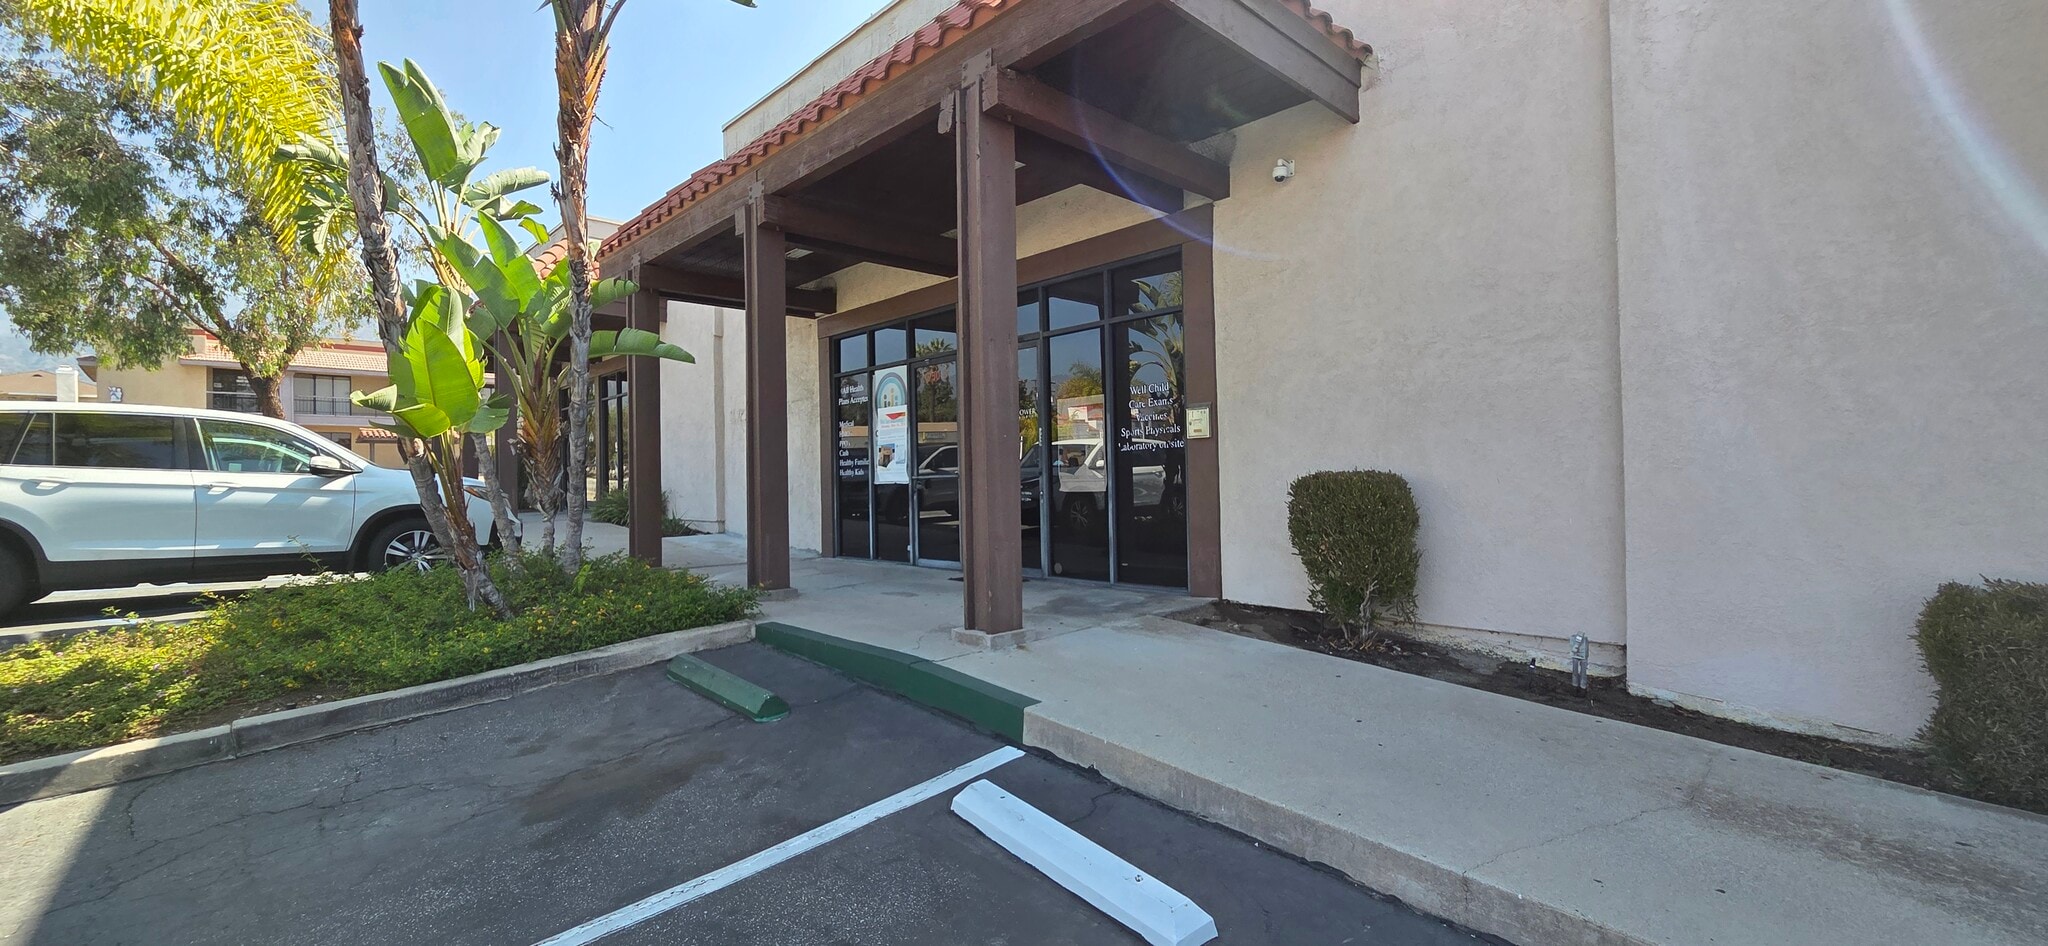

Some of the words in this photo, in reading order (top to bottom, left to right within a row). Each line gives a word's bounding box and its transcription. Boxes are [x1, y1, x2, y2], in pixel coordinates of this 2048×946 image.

[850, 384, 864, 393] Health
[1130, 385, 1147, 395] Well
[1148, 382, 1170, 394] Child
[839, 398, 850, 406] Plans
[850, 396, 869, 405] Accepte
[1129, 400, 1146, 410] Care
[1148, 397, 1175, 408] Exams
[1019, 408, 1038, 417] OWER
[1136, 412, 1168, 422] Vaccines
[1121, 427, 1144, 439] Sports
[1145, 424, 1181, 437] Physicals
[1118, 441, 1158, 452] Laboratory
[839, 449, 849, 457] Cash
[840, 469, 854, 477] Healthy
[855, 468, 865, 476] Kids
